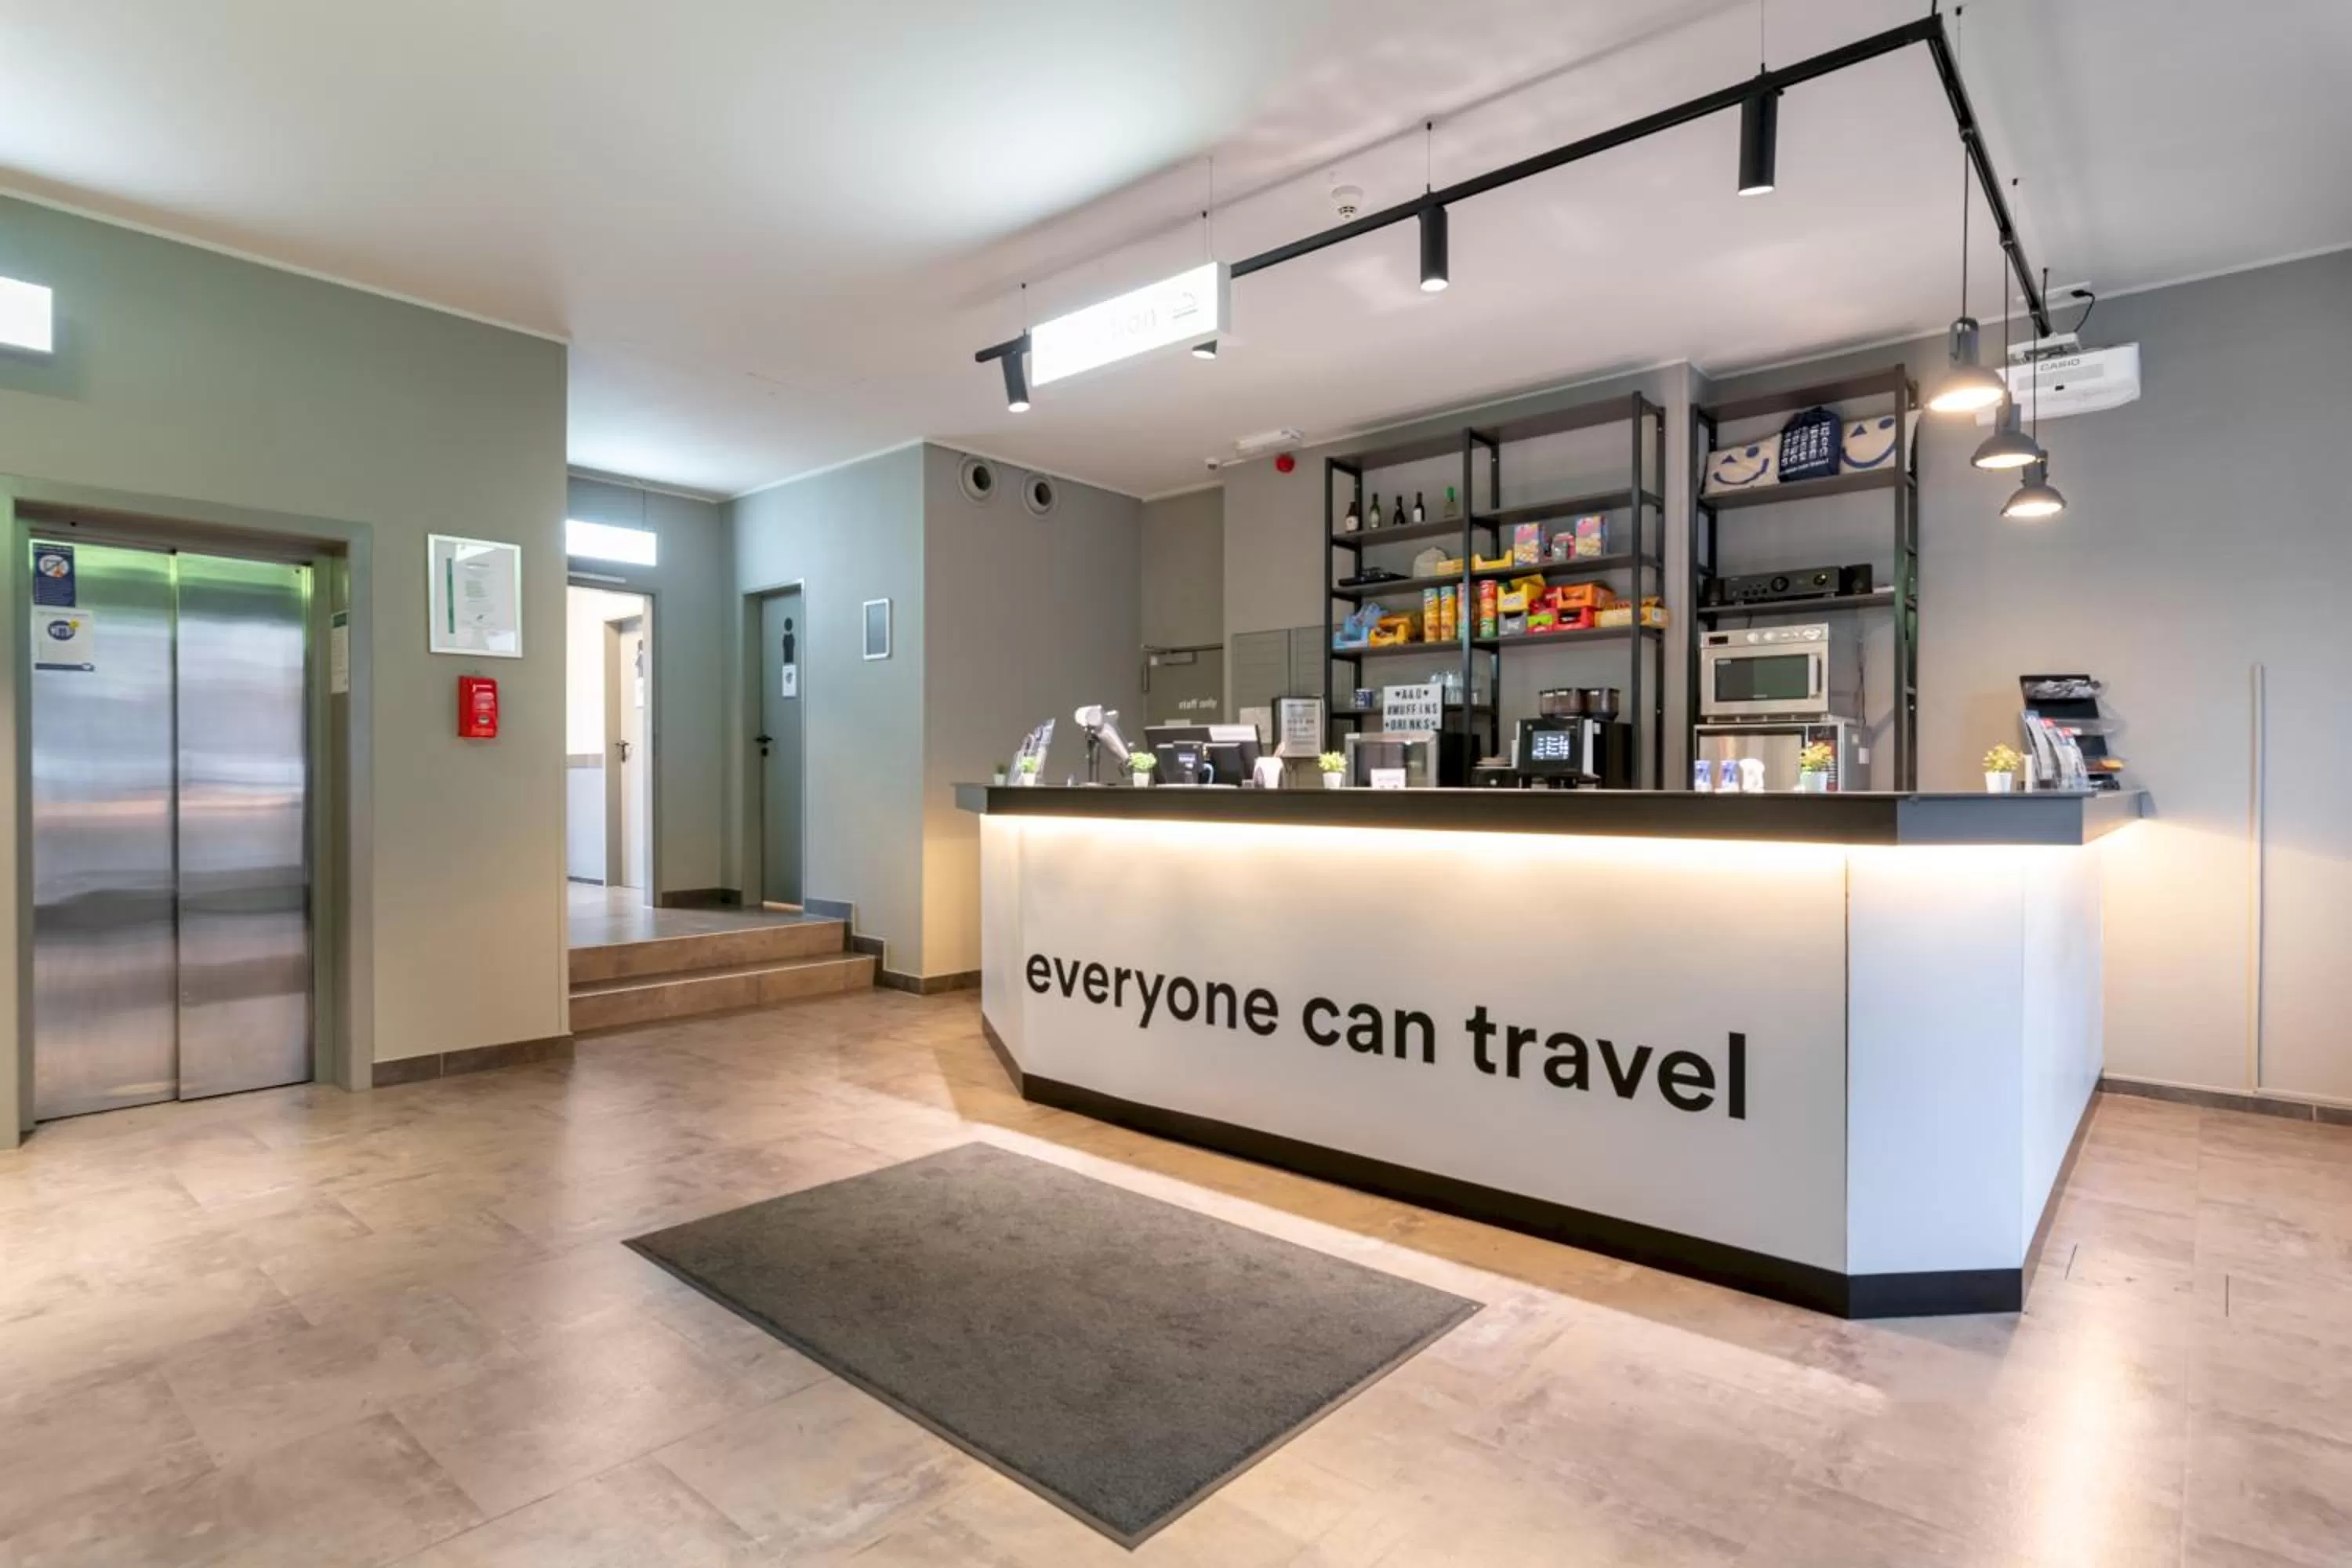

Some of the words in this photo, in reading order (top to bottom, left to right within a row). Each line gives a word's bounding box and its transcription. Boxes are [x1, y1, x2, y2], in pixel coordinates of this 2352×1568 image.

[1026, 953, 1279, 1036] everyone
[1302, 996, 1436, 1064] can
[1465, 1005, 1746, 1120] travel
